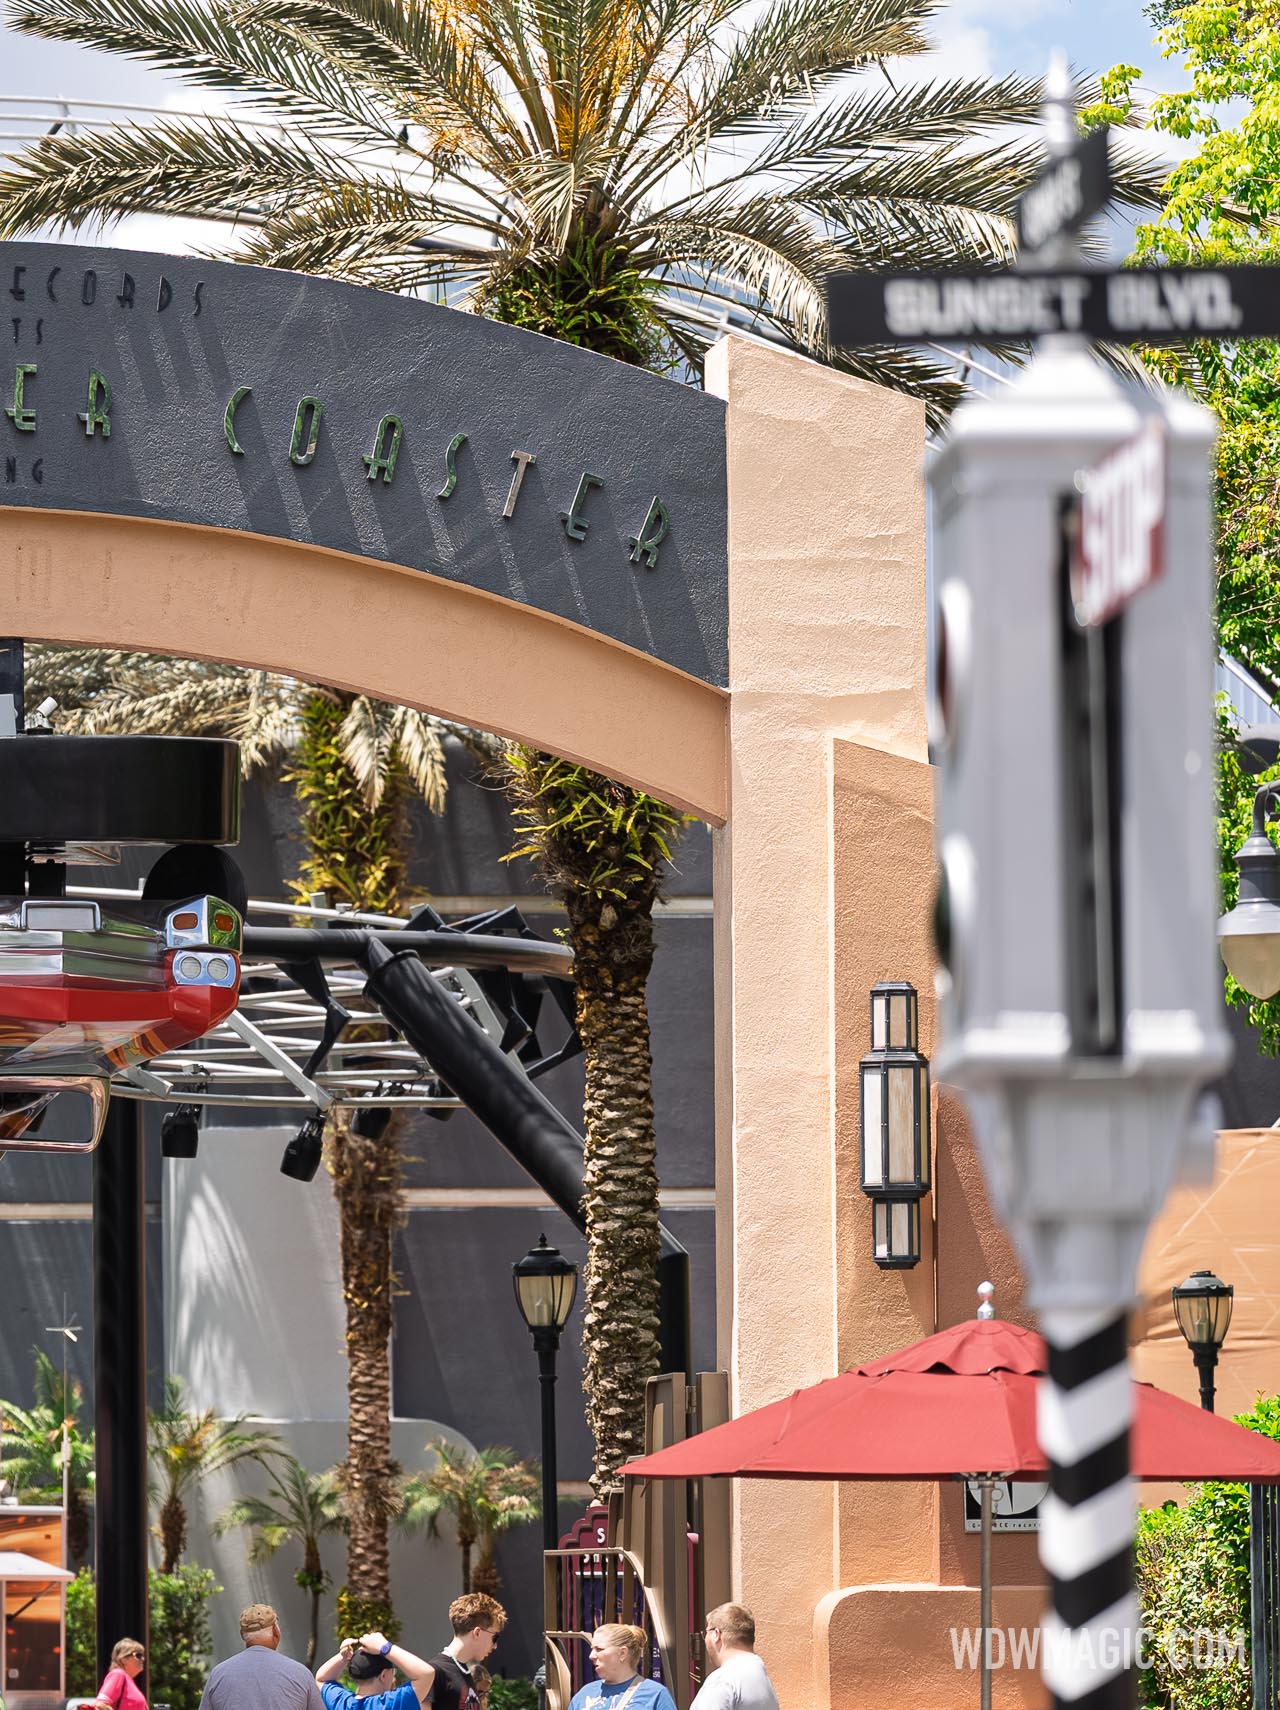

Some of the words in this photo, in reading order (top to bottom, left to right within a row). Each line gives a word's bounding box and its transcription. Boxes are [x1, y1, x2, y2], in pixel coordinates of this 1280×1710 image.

[883, 276, 1089, 336] SUNSET
[1107, 273, 1242, 331] BLVD.
[224, 386, 671, 568] COASTER
